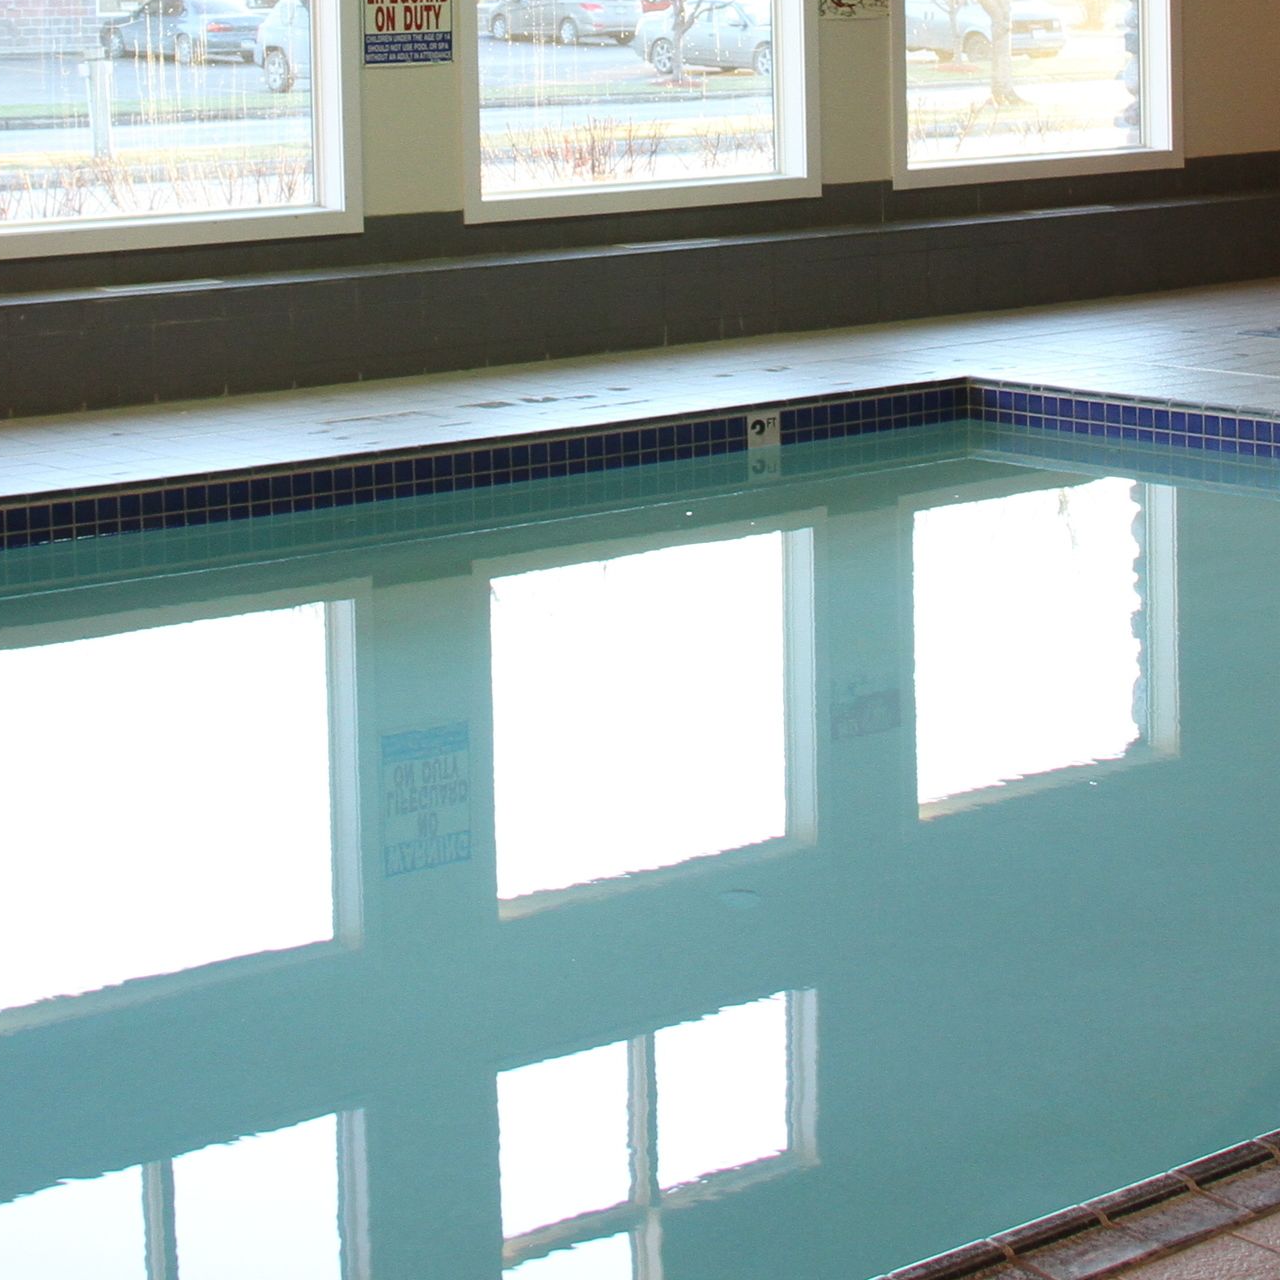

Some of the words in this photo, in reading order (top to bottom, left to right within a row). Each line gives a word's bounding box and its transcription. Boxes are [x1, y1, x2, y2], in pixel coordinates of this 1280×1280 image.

[375, 6, 395, 32] ON
[403, 5, 442, 31] DUTY
[766, 416, 776, 429] FT
